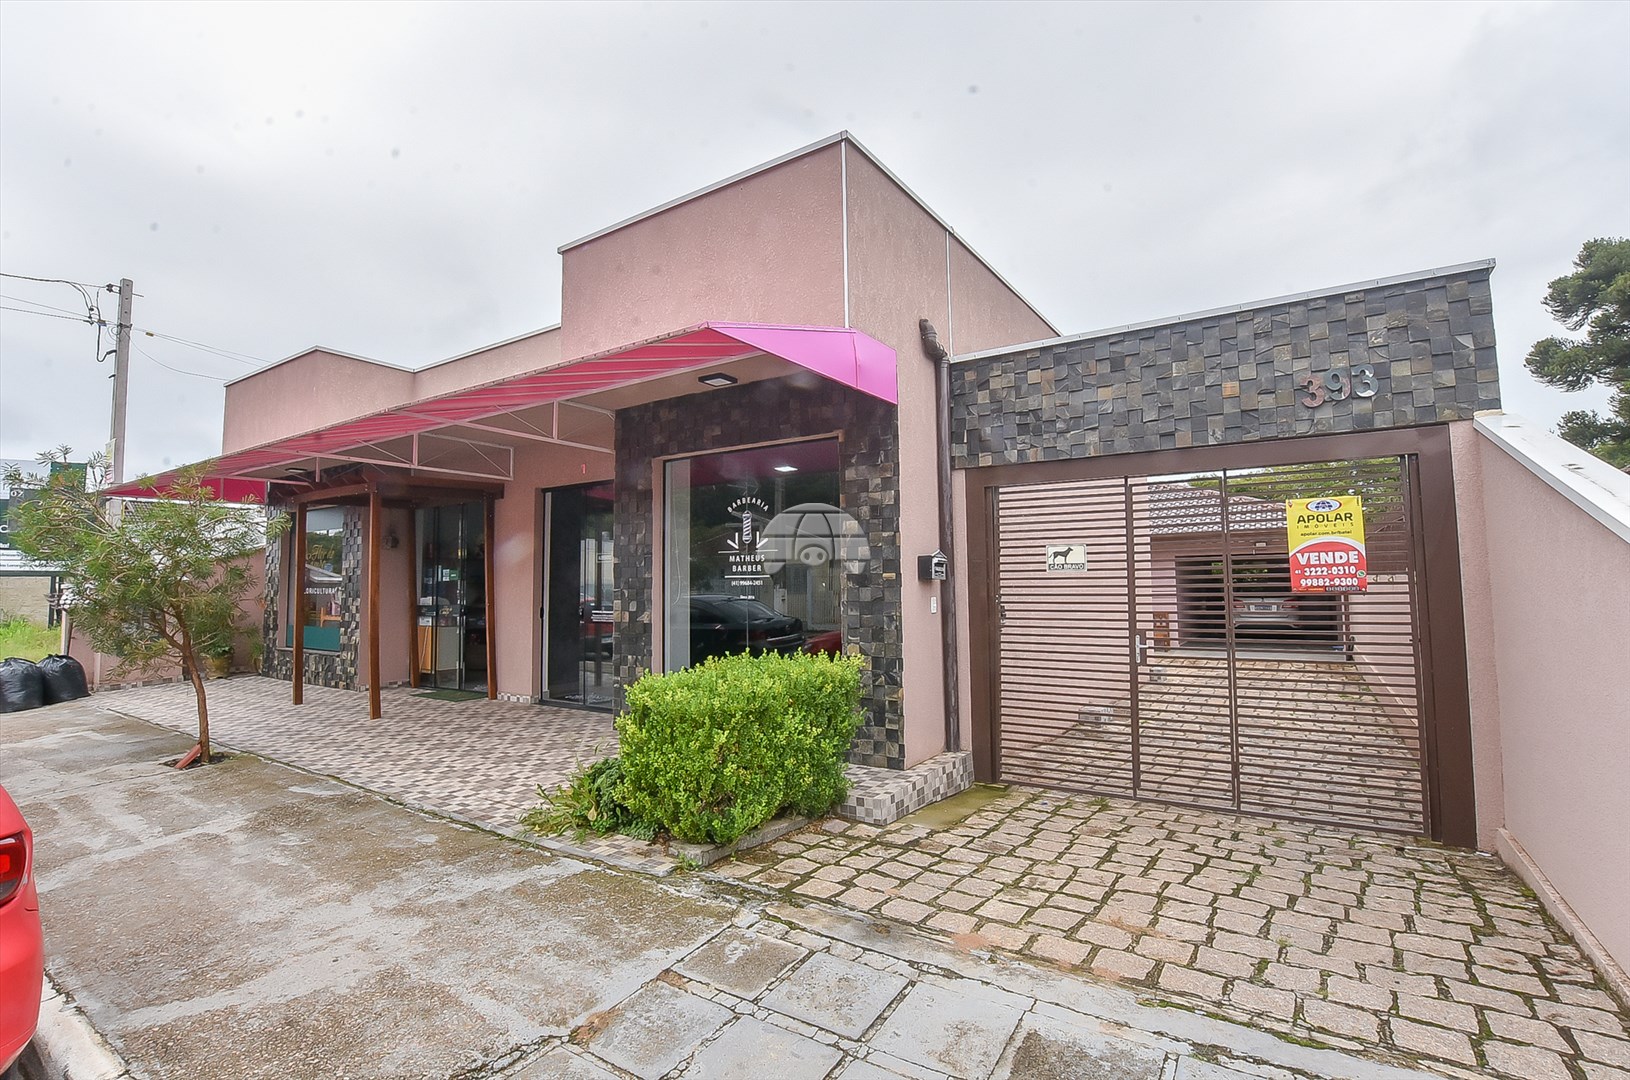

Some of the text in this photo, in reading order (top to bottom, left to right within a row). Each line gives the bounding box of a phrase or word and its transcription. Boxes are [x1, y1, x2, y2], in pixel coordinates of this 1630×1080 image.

[1300, 364, 1379, 408] 393
[727, 496, 769, 513] BARBEARIA
[1297, 512, 1353, 524] APOLAR
[729, 554, 765, 562] MATHEUS
[1295, 551, 1359, 565] VENDE
[732, 564, 762, 572] BARBER
[1304, 566, 1356, 576] 3222-0310
[1300, 577, 1359, 587] 99882-9300
